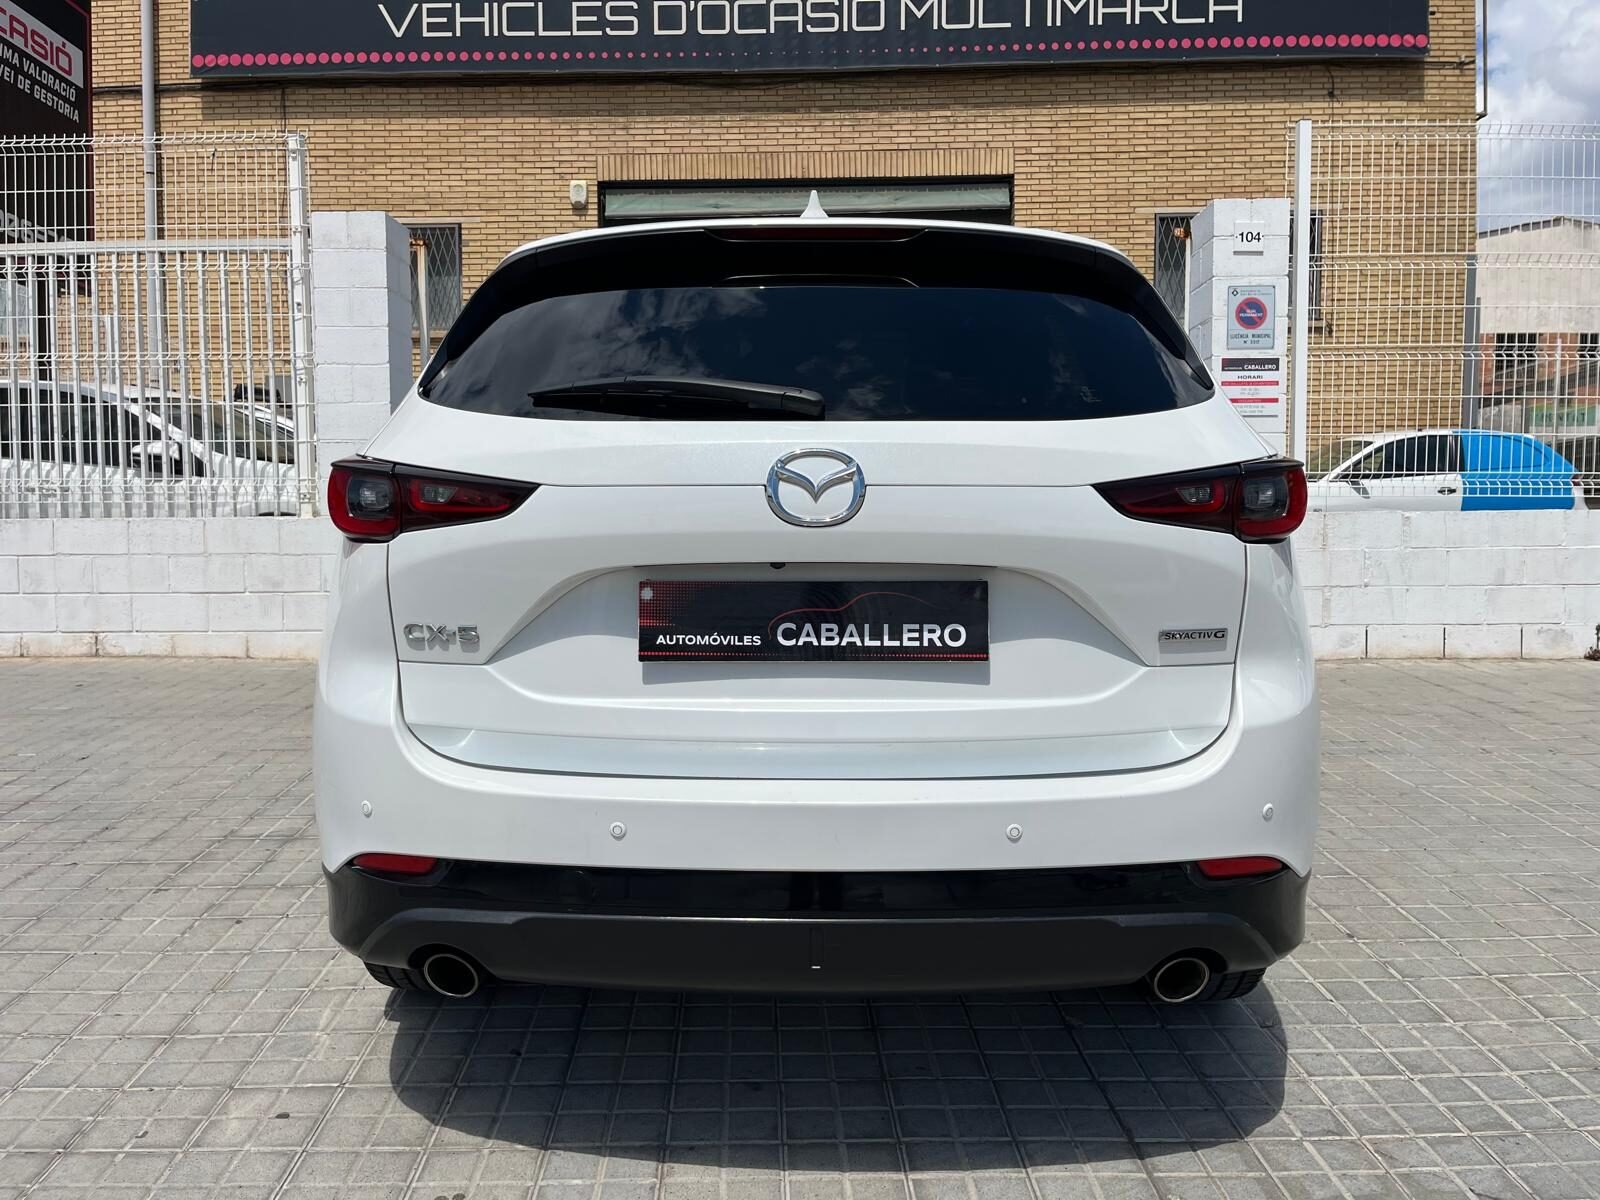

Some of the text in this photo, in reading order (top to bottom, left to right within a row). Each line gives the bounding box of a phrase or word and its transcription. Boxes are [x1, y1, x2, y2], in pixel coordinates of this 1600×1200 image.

[378, 1, 638, 37] VEHICLES
[23, 57, 76, 102] VALORACIÓ
[17, 74, 31, 94] DE
[34, 84, 80, 124] GESTORIA
[1238, 231, 1261, 243] 104
[403, 623, 480, 646] CX-5
[656, 622, 967, 648] AUTOMÓVILES CABALLERO
